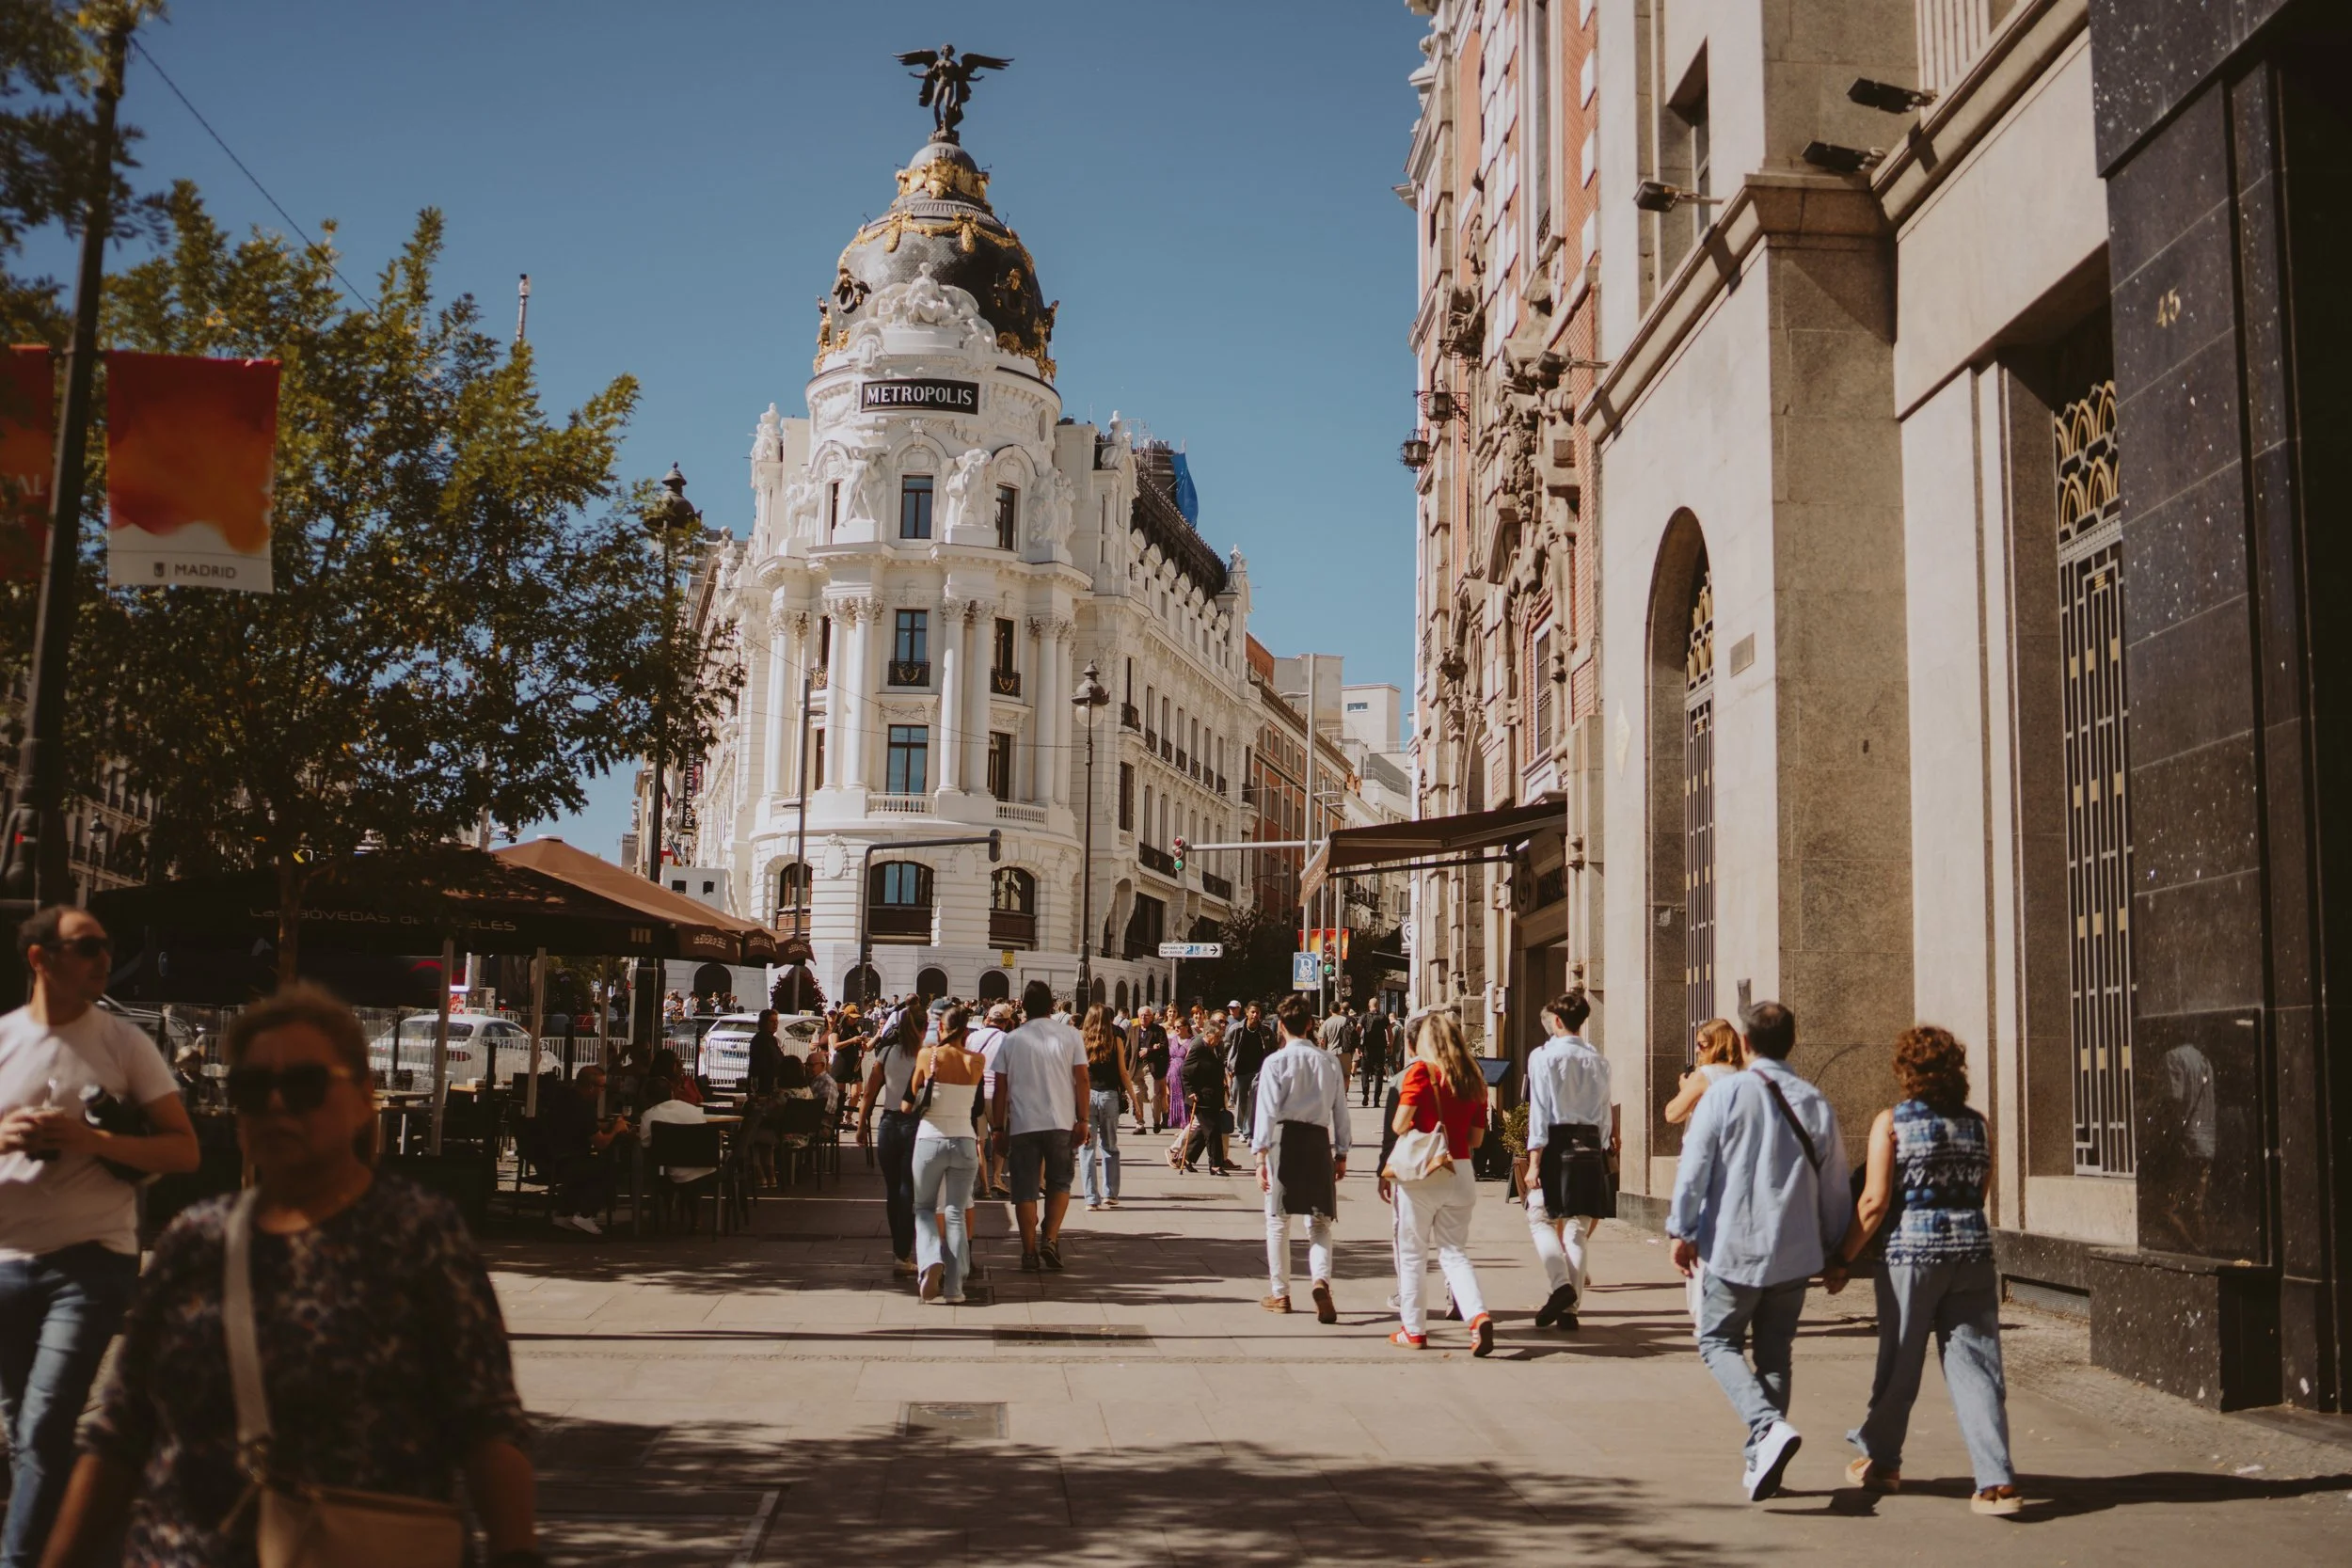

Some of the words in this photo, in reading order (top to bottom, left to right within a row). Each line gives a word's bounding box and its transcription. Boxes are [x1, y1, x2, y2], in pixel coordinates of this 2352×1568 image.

[2155, 284, 2182, 329] 45
[866, 385, 973, 405] METROPOLIS
[174, 563, 237, 579] MADRID
[685, 807, 693, 827] POR
